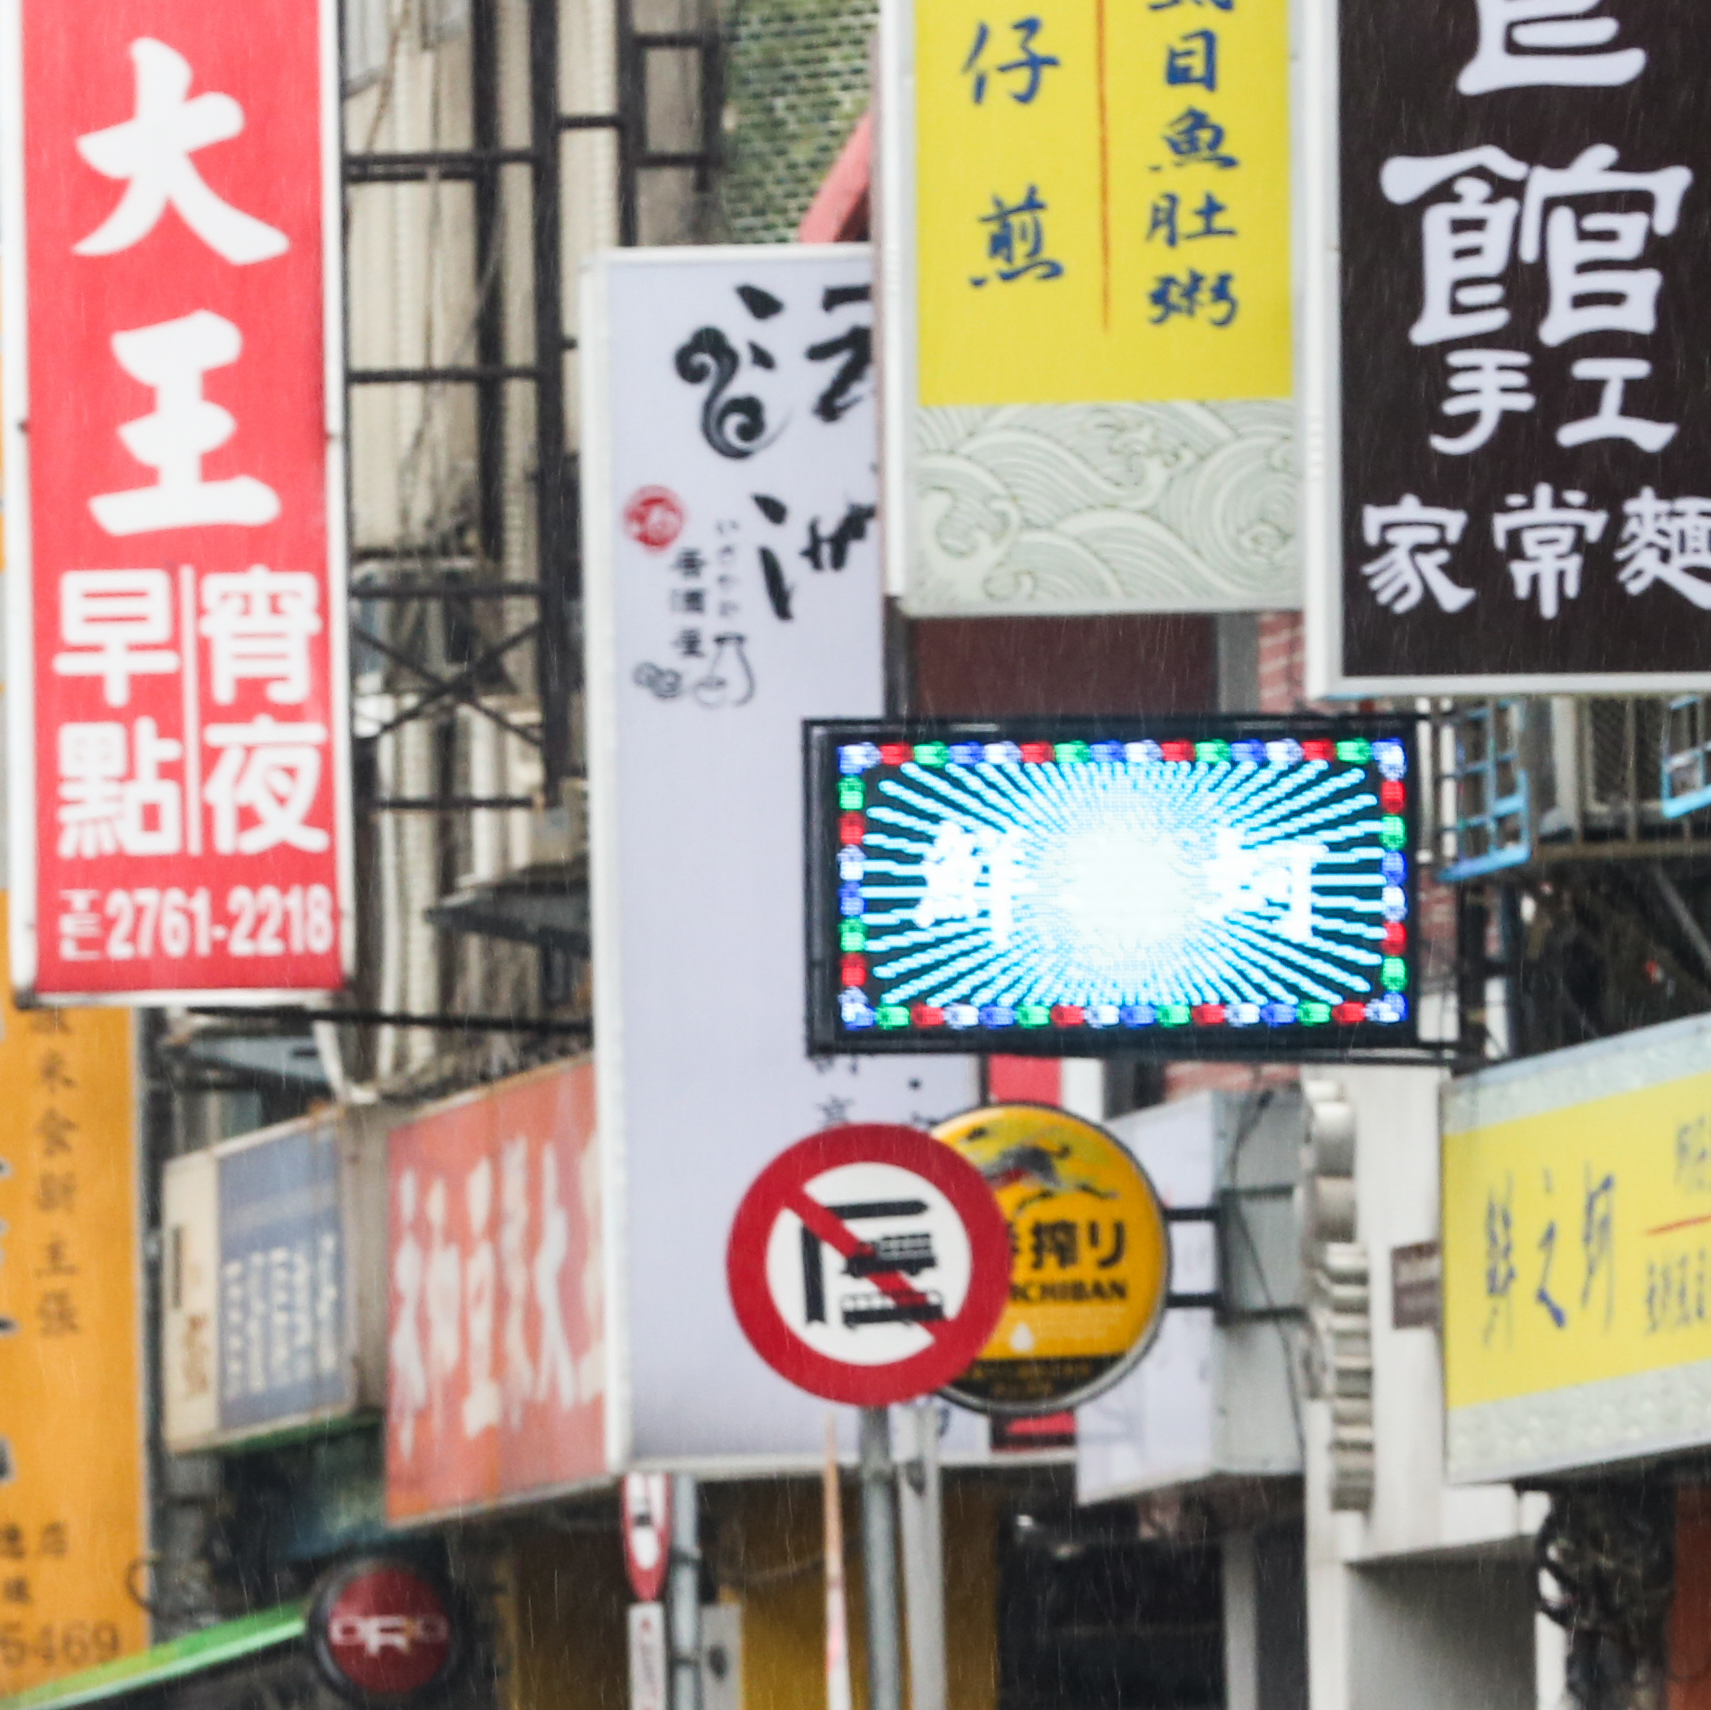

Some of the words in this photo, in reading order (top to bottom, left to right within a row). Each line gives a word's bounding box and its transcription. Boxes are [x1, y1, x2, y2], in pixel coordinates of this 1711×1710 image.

[71, 36, 290, 537] 大王
[1429, 350, 1679, 456] 手工
[1360, 483, 1711, 619] 家常麵
[53, 567, 181, 859] 早點
[200, 565, 329, 856] 宵夜
[105, 885, 336, 960] 2761-2218
